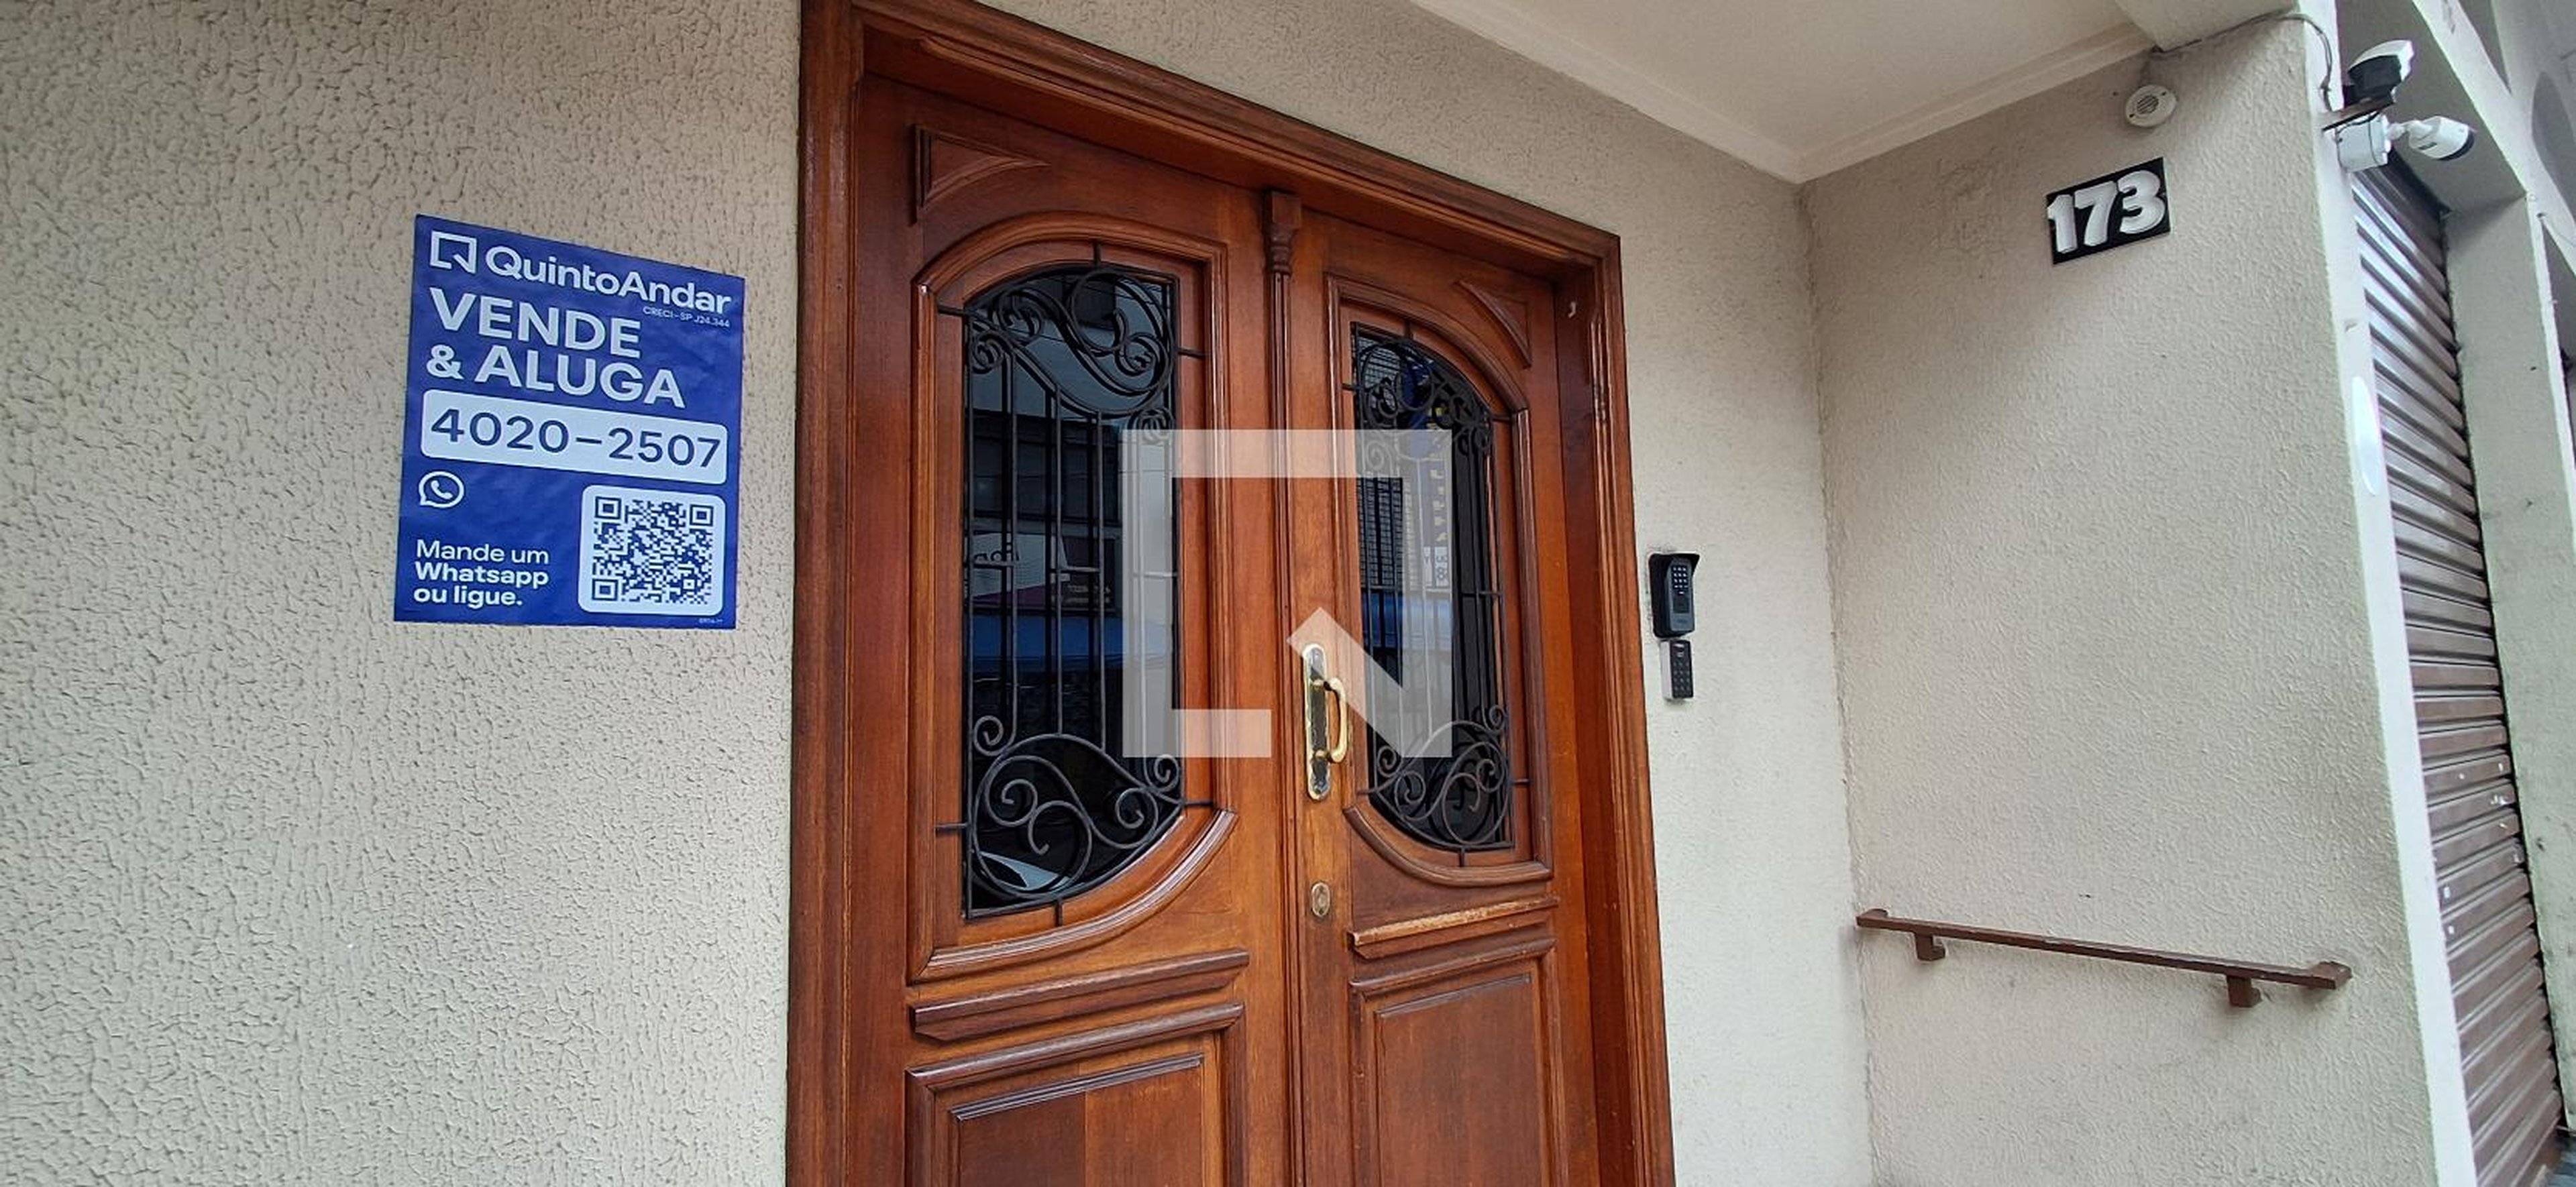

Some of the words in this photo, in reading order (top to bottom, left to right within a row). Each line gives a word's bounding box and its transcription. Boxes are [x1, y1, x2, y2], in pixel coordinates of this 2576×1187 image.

[2047, 170, 2165, 254] 173
[485, 245, 732, 315] QuintoAndar
[430, 287, 641, 358] VENDE
[427, 344, 464, 380] &
[474, 345, 685, 408] ALUGA
[431, 408, 721, 468] 4020-2507
[415, 561, 549, 589] Whatsapp
[417, 539, 505, 563] Mande
[511, 549, 549, 564] um
[413, 588, 447, 603] ou
[454, 585, 523, 610] ligue.
